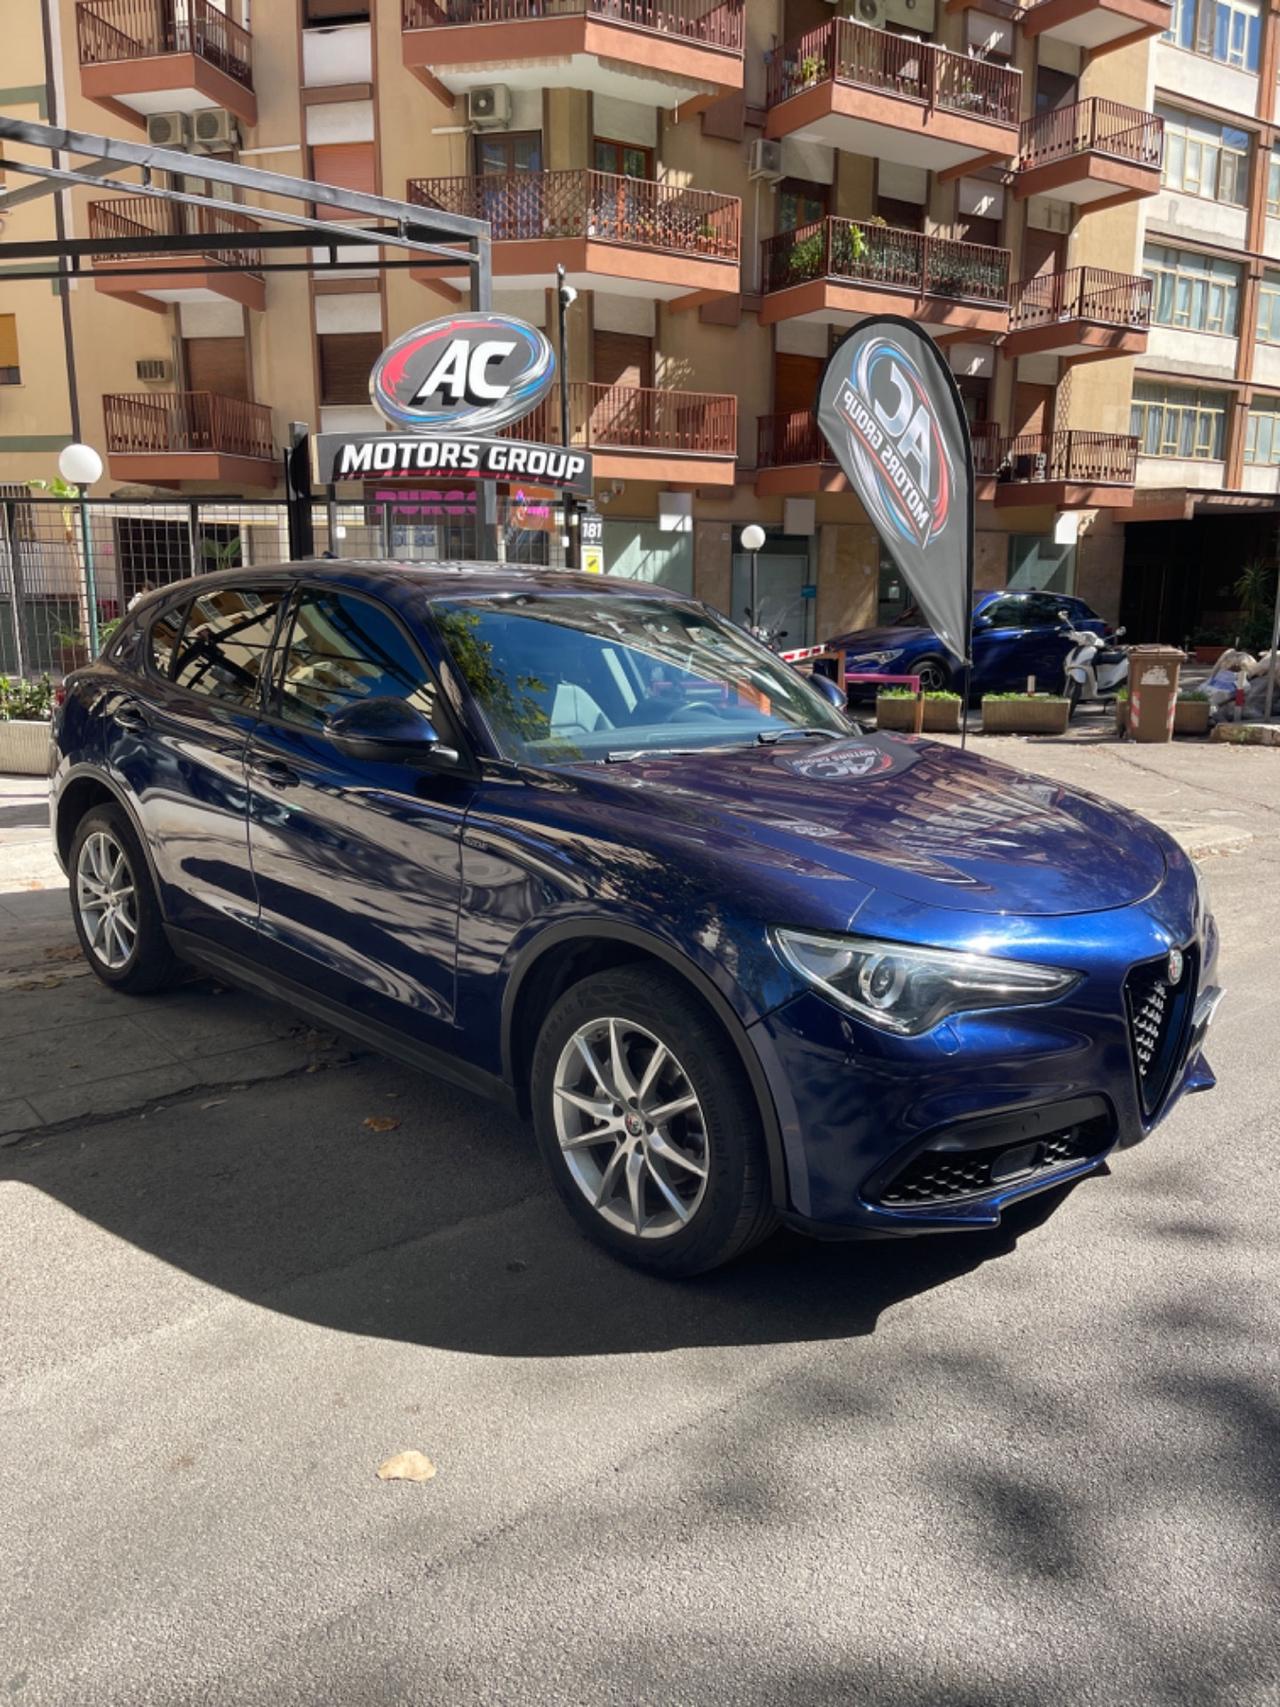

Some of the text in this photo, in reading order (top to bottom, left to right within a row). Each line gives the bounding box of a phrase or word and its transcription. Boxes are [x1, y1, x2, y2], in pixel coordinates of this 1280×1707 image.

[414, 338, 518, 403] AC
[339, 441, 586, 480] MOTORS GROUP
[582, 522, 603, 538] 181
